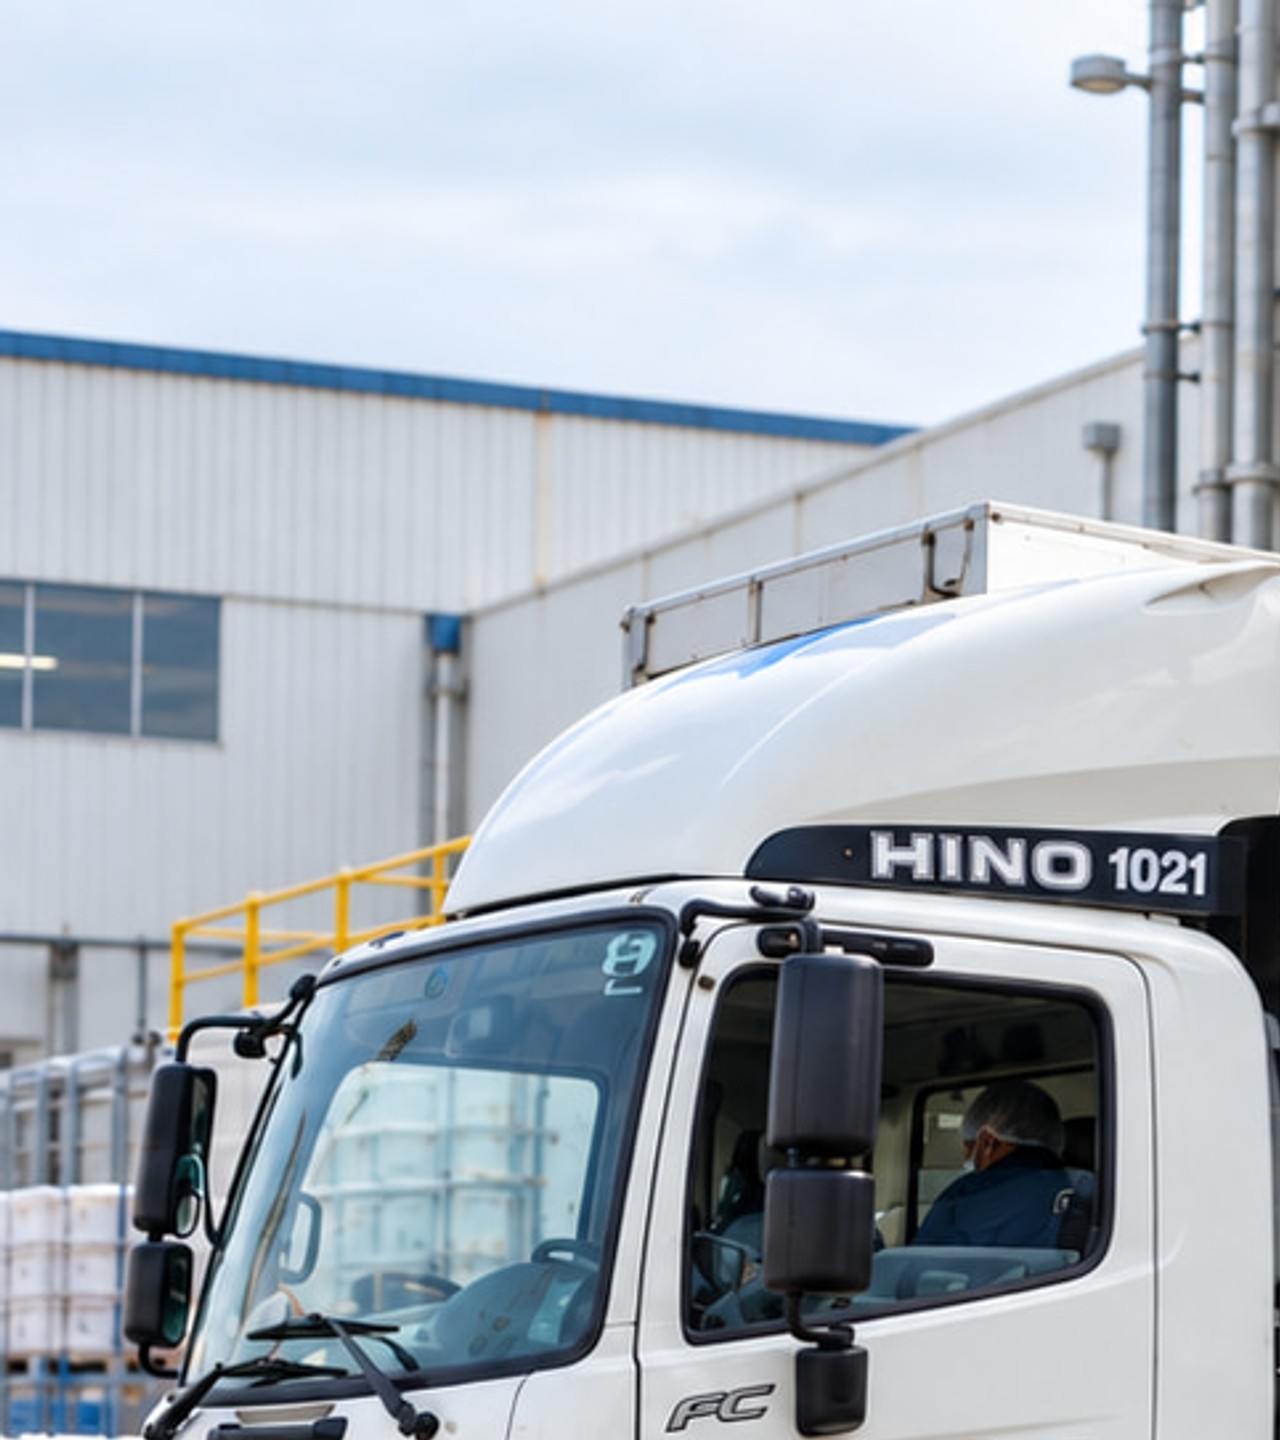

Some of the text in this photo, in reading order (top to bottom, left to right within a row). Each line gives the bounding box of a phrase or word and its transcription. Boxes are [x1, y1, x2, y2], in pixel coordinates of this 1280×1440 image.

[870, 830, 1207, 896] HINO 1021
[666, 1385, 775, 1433] FC
